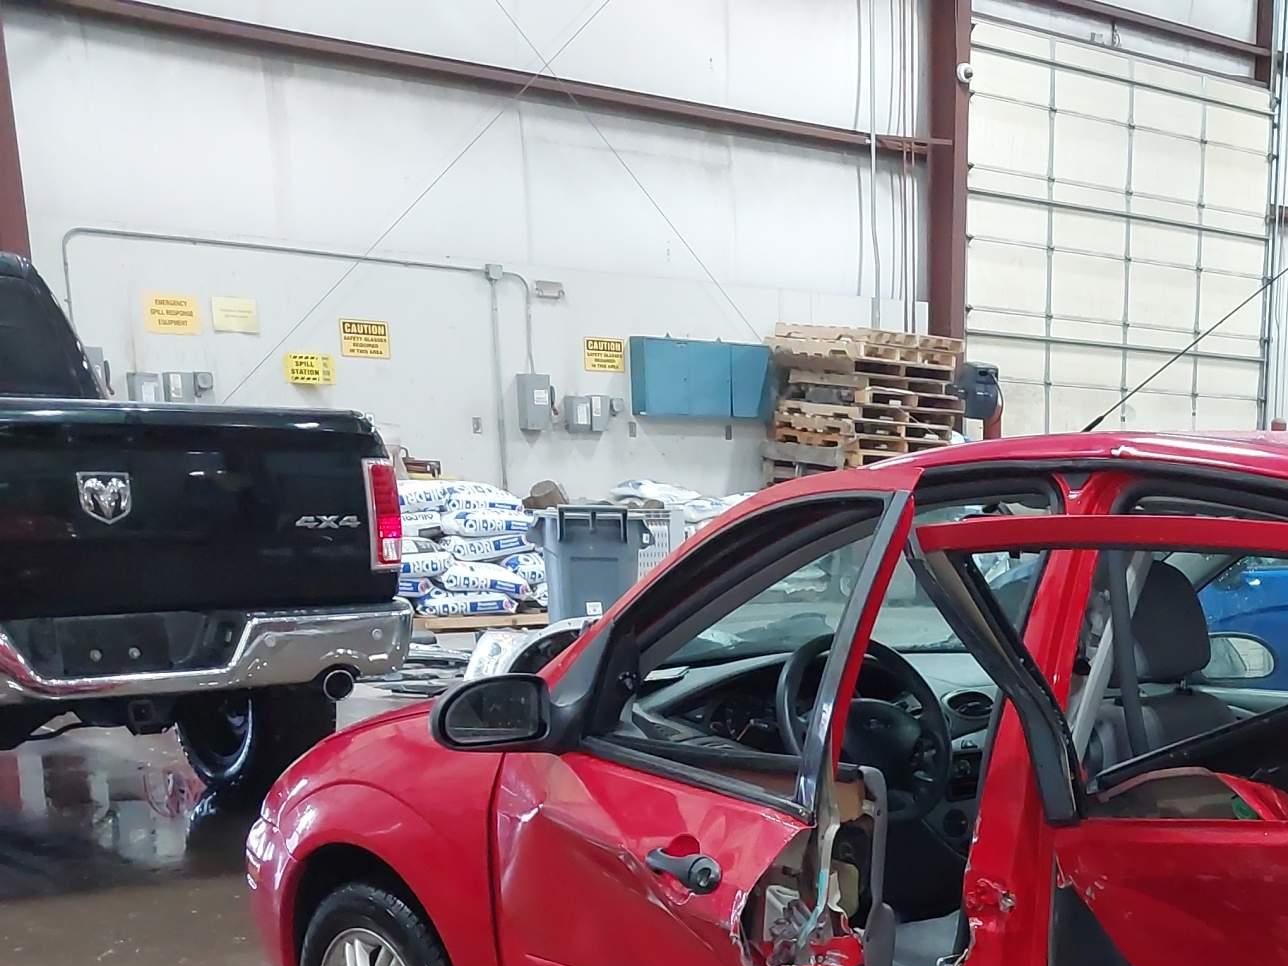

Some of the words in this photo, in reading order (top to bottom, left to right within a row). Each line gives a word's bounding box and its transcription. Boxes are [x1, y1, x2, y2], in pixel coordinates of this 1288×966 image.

[154, 298, 188, 307] EMERGENCY
[343, 322, 385, 335] CAUTION
[587, 340, 621, 351] CAUTION
[290, 368, 320, 376] STATION
[295, 515, 361, 529] 4X4
